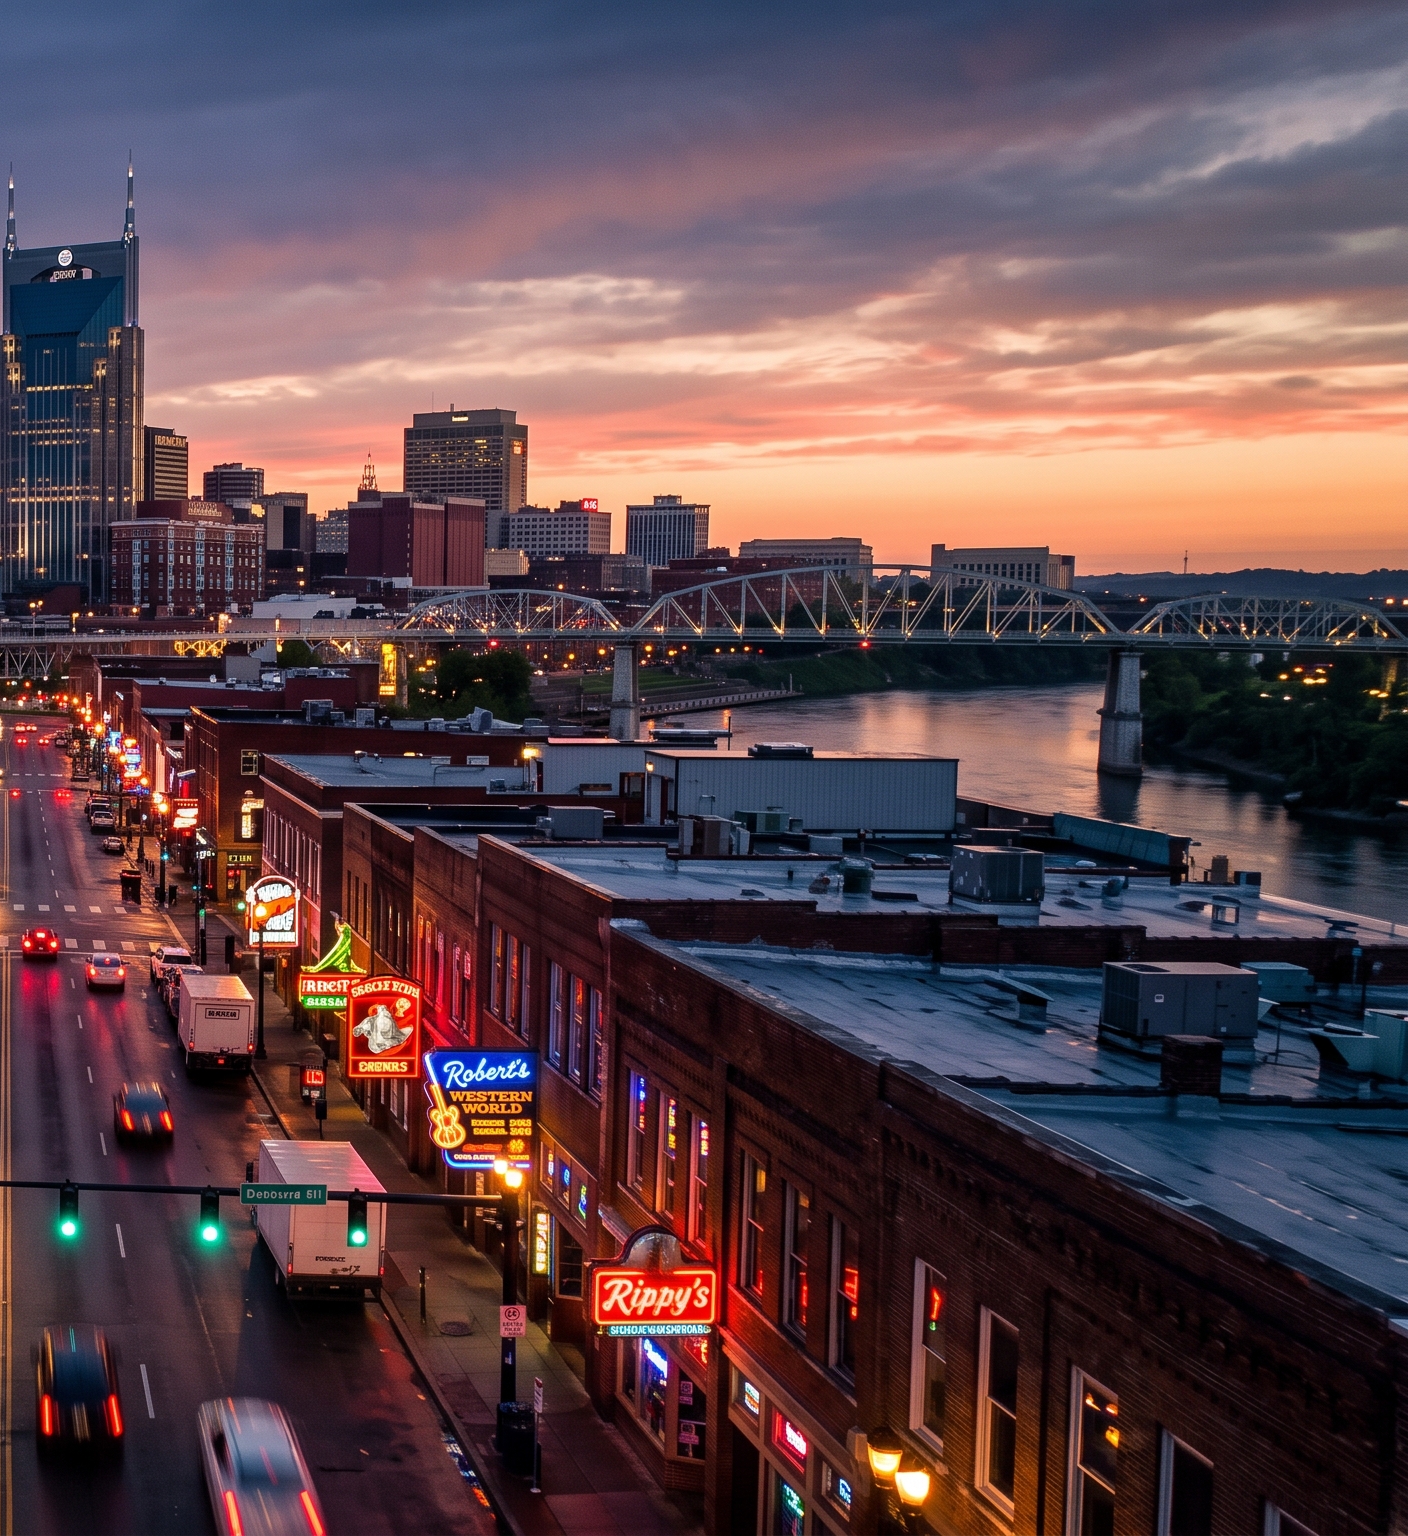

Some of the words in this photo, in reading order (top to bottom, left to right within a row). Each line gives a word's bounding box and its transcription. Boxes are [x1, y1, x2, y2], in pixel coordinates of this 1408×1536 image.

[443, 1058, 530, 1088] Robert's
[449, 1091, 533, 1102] WESTERN
[461, 1103, 523, 1114] WORLD
[602, 1277, 710, 1317] Rippy's
